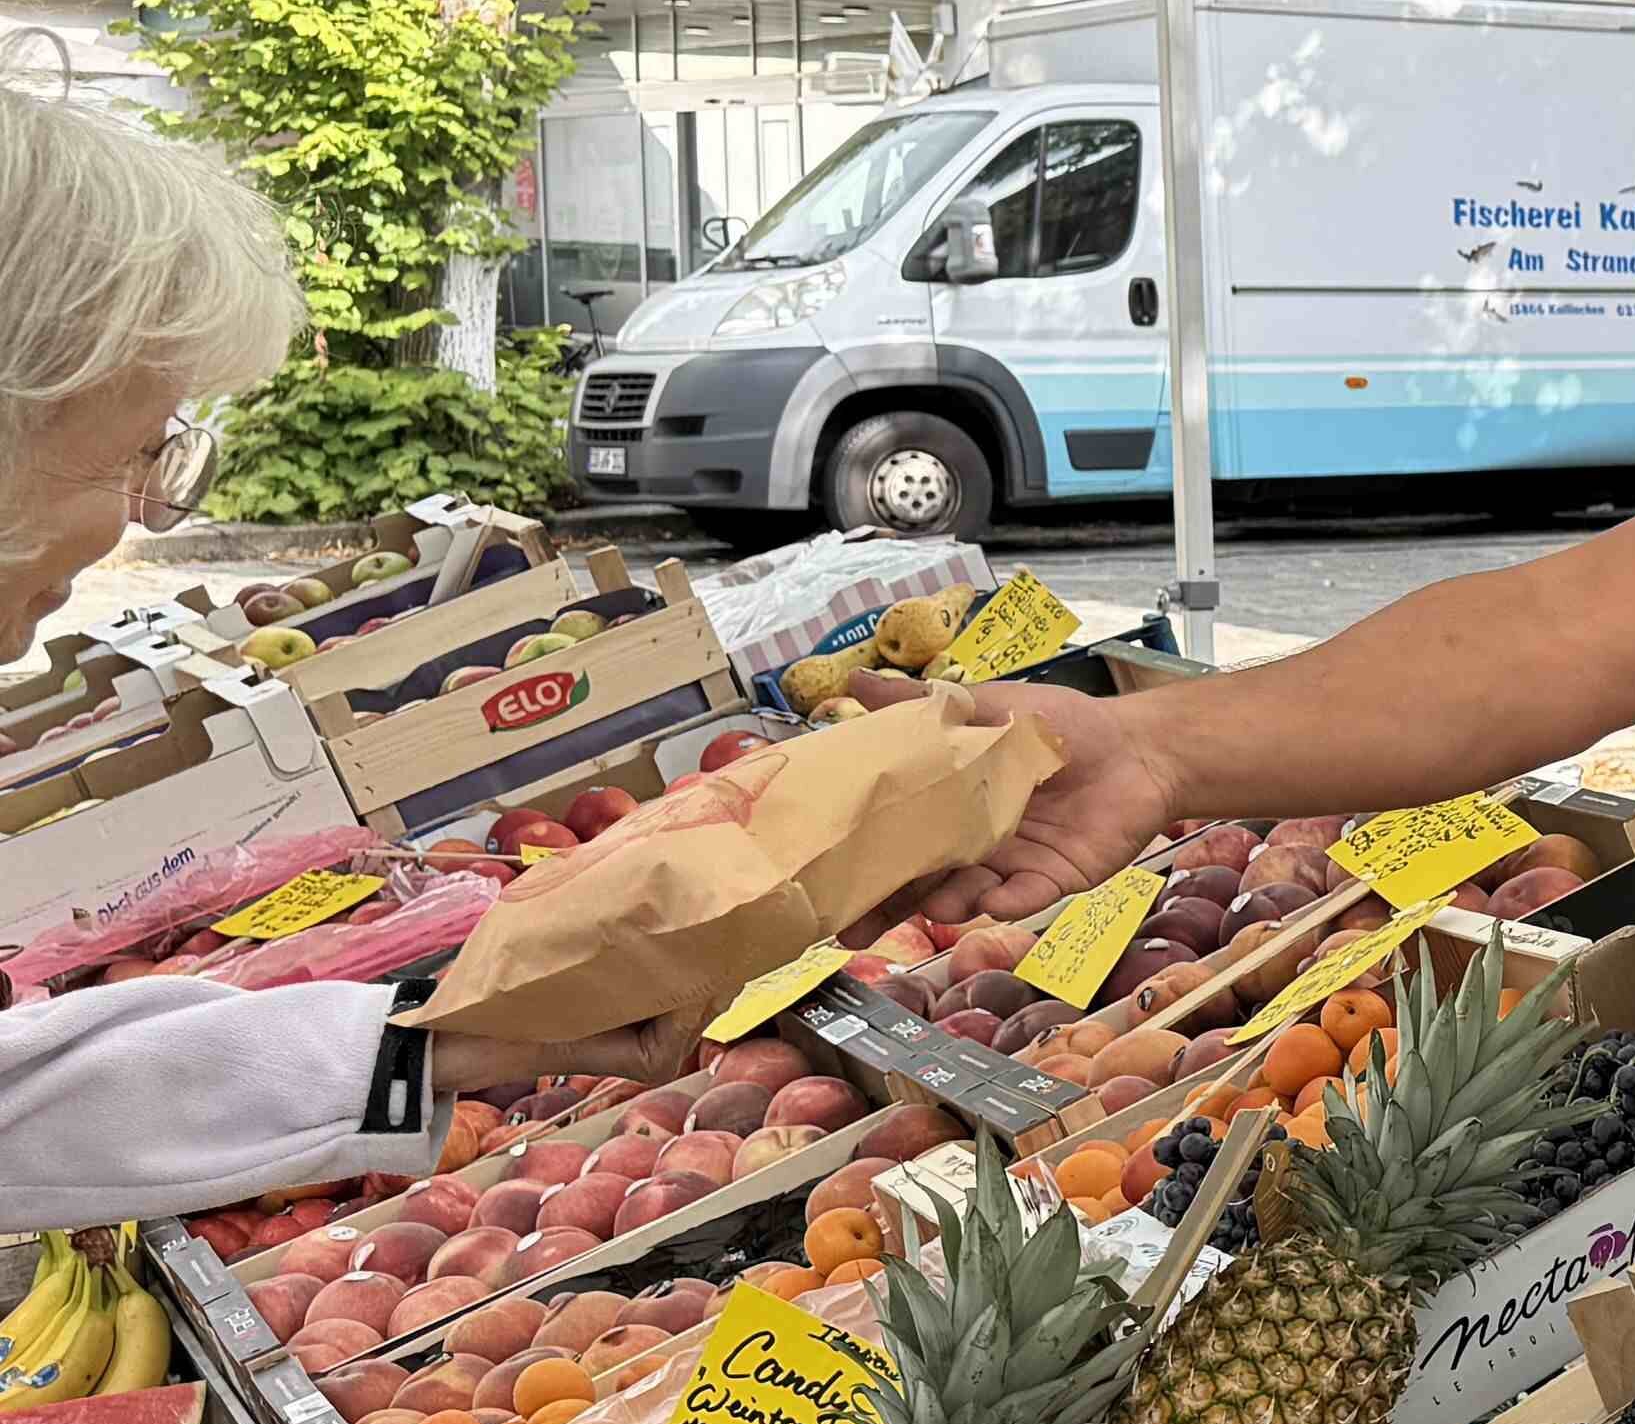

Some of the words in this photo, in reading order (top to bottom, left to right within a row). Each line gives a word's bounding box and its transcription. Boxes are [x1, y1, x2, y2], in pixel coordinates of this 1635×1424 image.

[1452, 197, 1582, 230] Fischerei
[1508, 247, 1544, 272] Am
[497, 679, 563, 722] ELO
[135, 870, 162, 902] aus
[161, 846, 196, 877] dem
